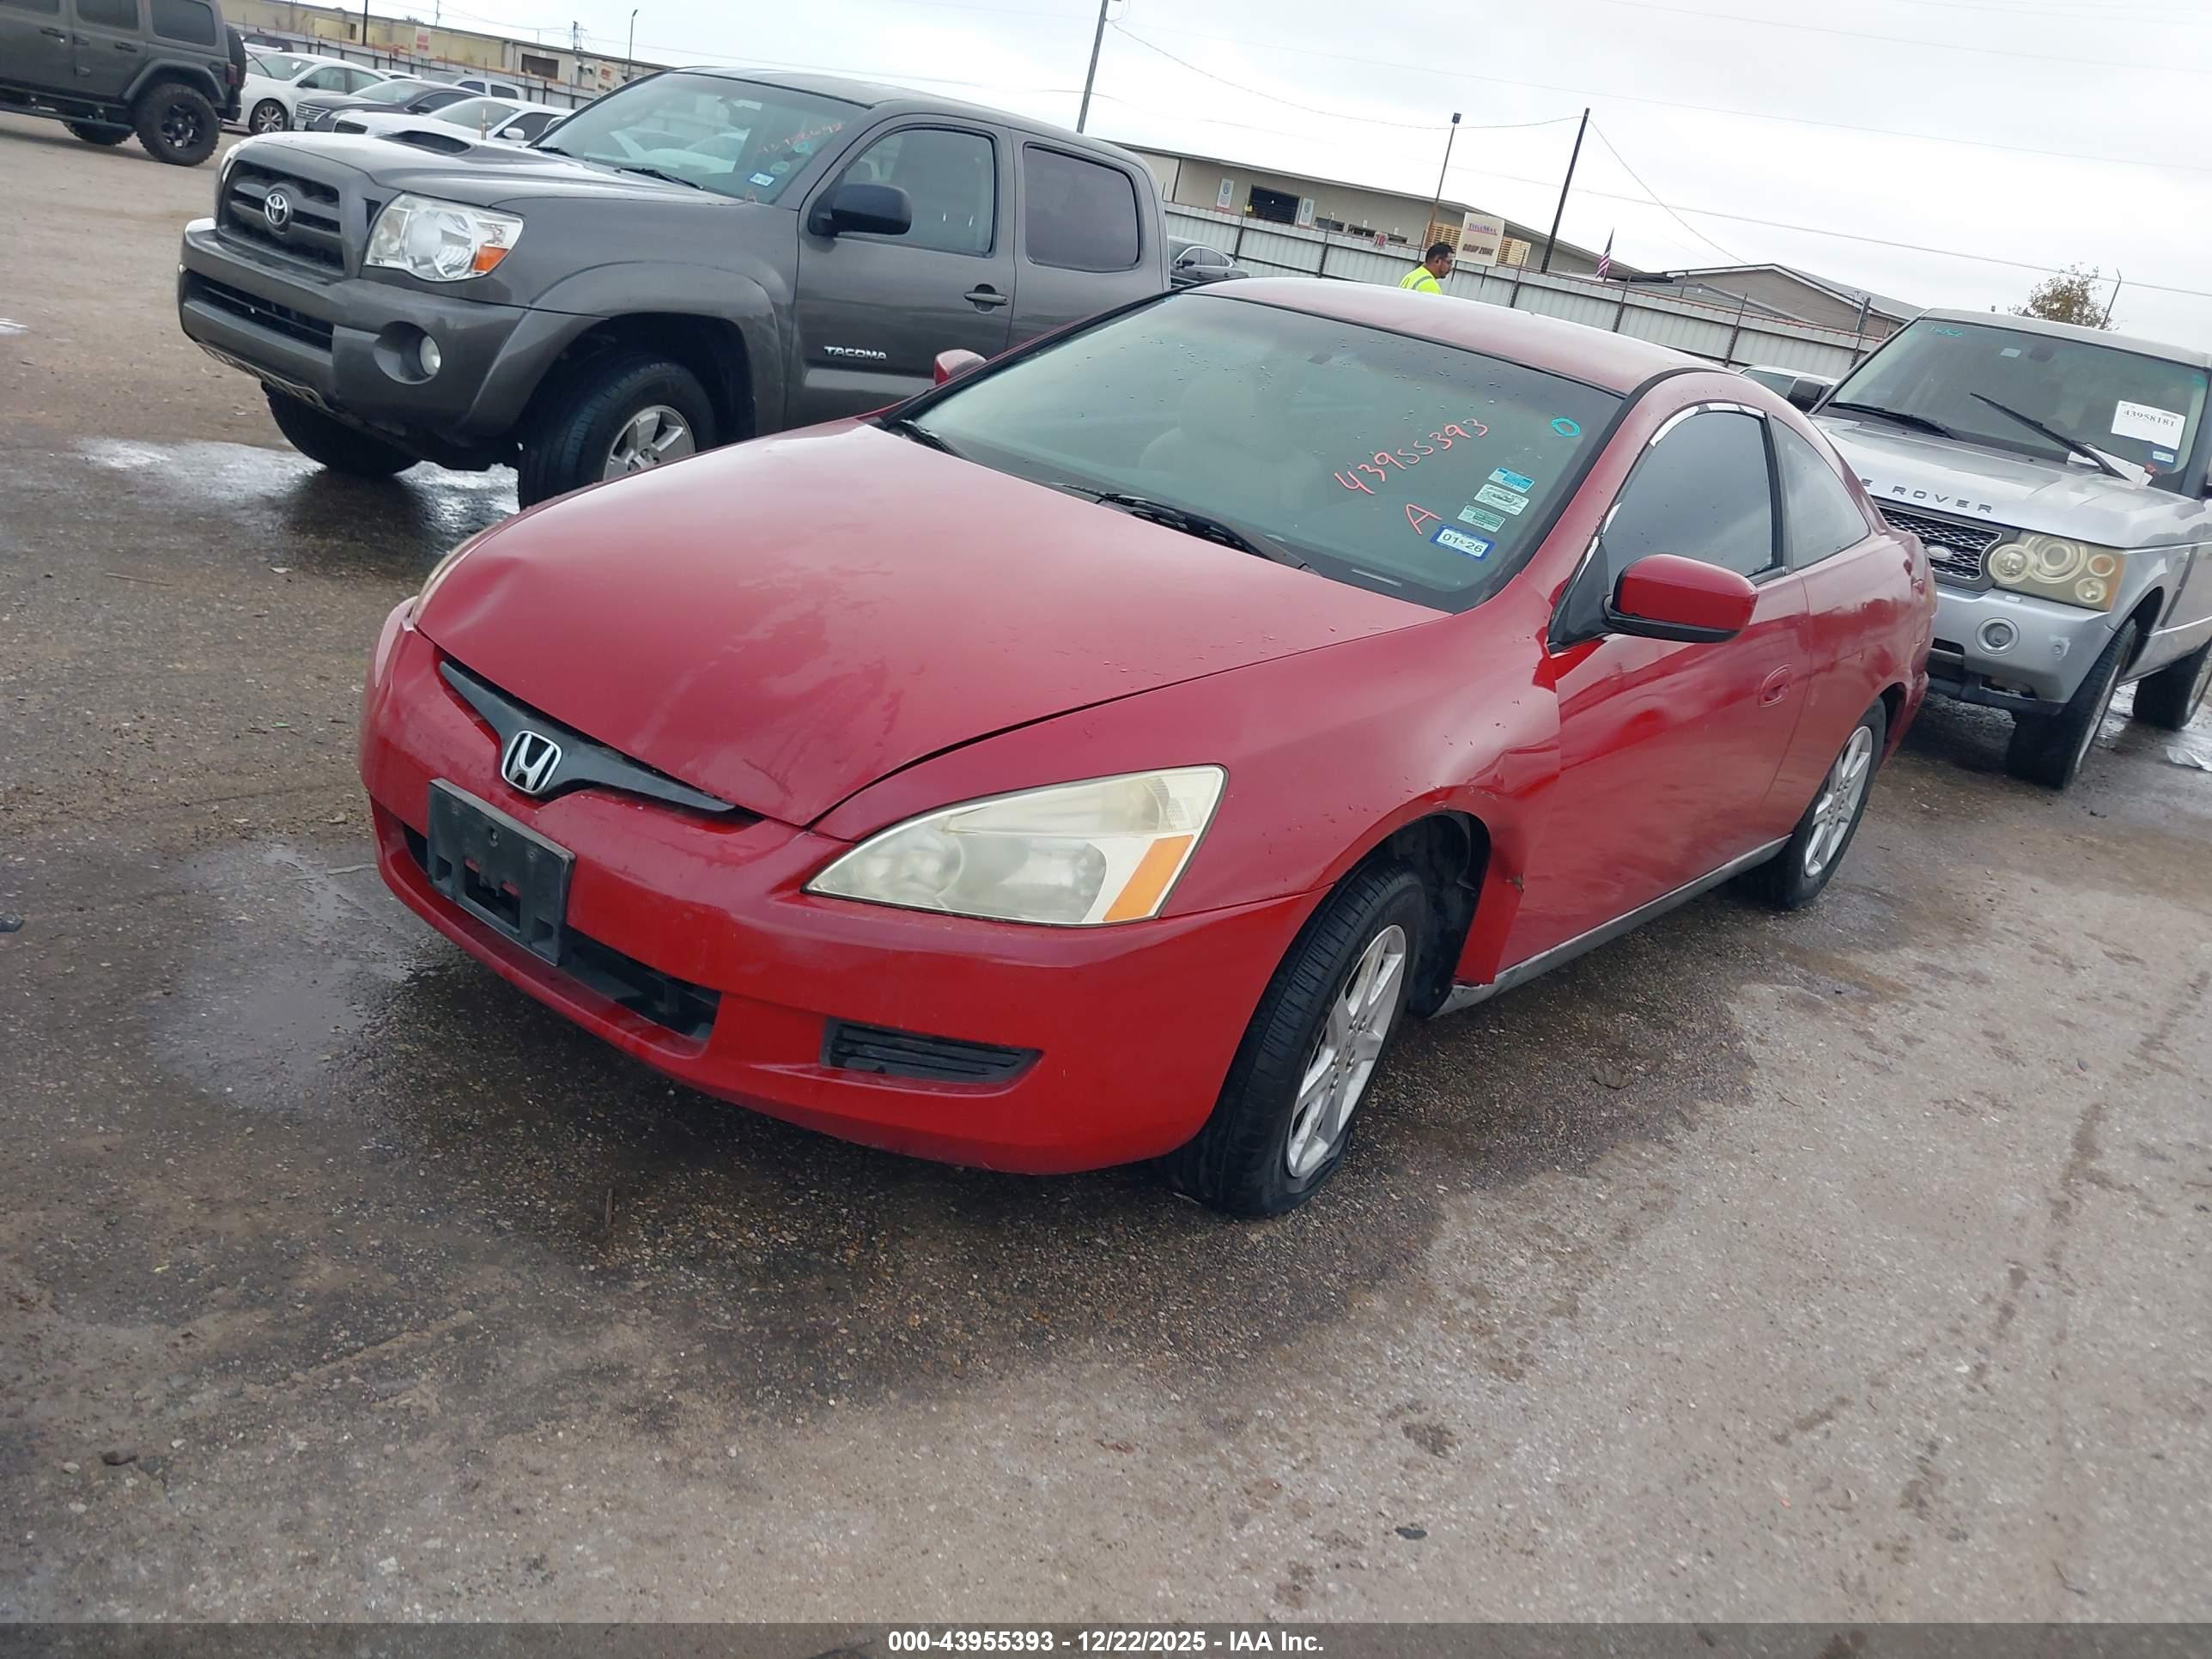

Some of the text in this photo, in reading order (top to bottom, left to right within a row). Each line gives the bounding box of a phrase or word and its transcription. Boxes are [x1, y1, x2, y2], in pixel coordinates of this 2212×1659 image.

[824, 345, 887, 360] TACOMA
[1334, 418, 1489, 495] 43955393
[1892, 485, 1993, 514] ROVER
[1405, 503, 1443, 535] A
